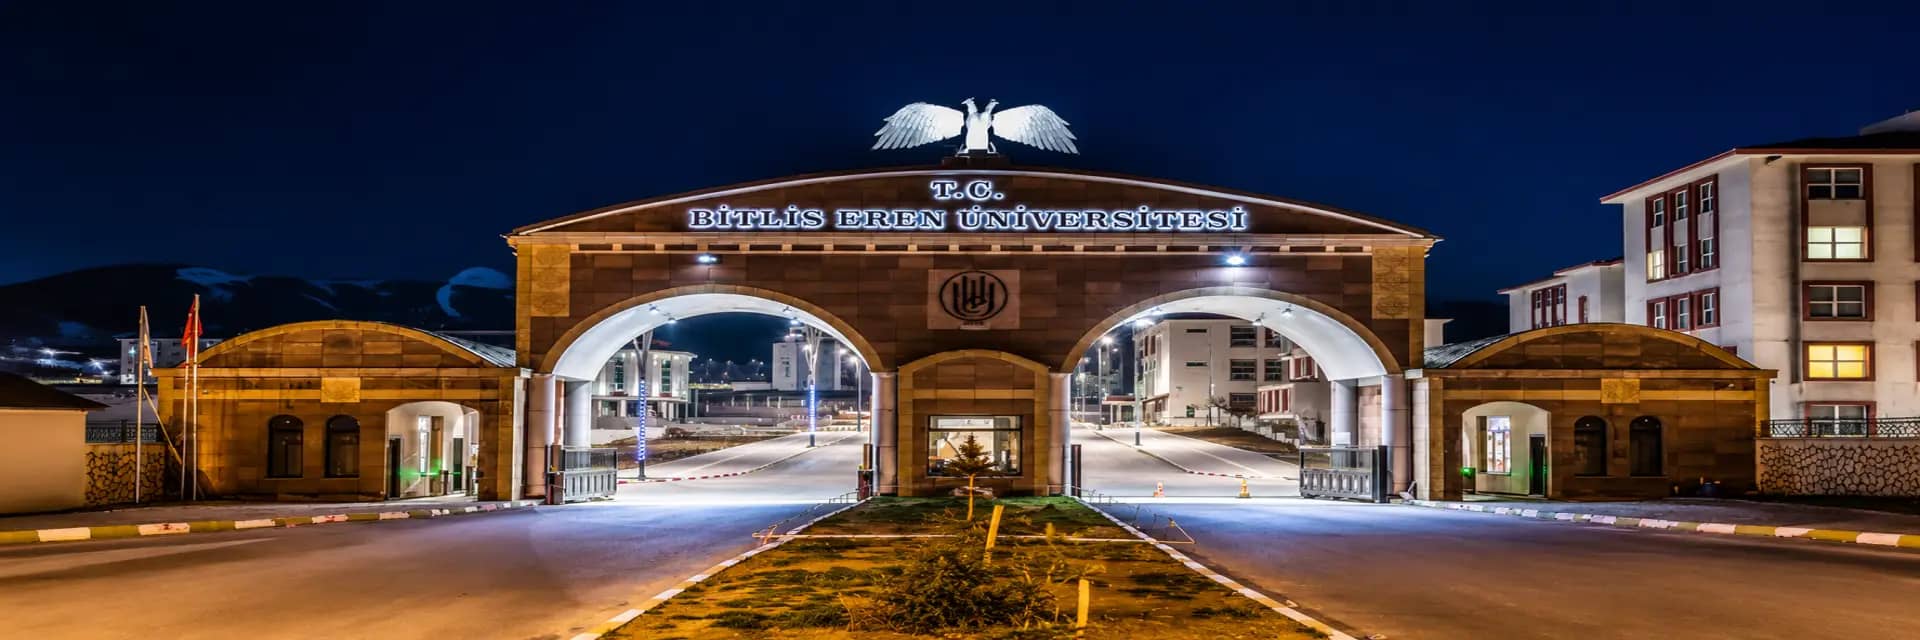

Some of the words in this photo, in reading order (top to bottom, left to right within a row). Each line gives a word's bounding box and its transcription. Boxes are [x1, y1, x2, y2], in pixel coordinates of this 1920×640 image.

[931, 181, 1004, 200] T.C.
[689, 206, 823, 228] BİTLİS
[836, 210, 945, 229] EREN
